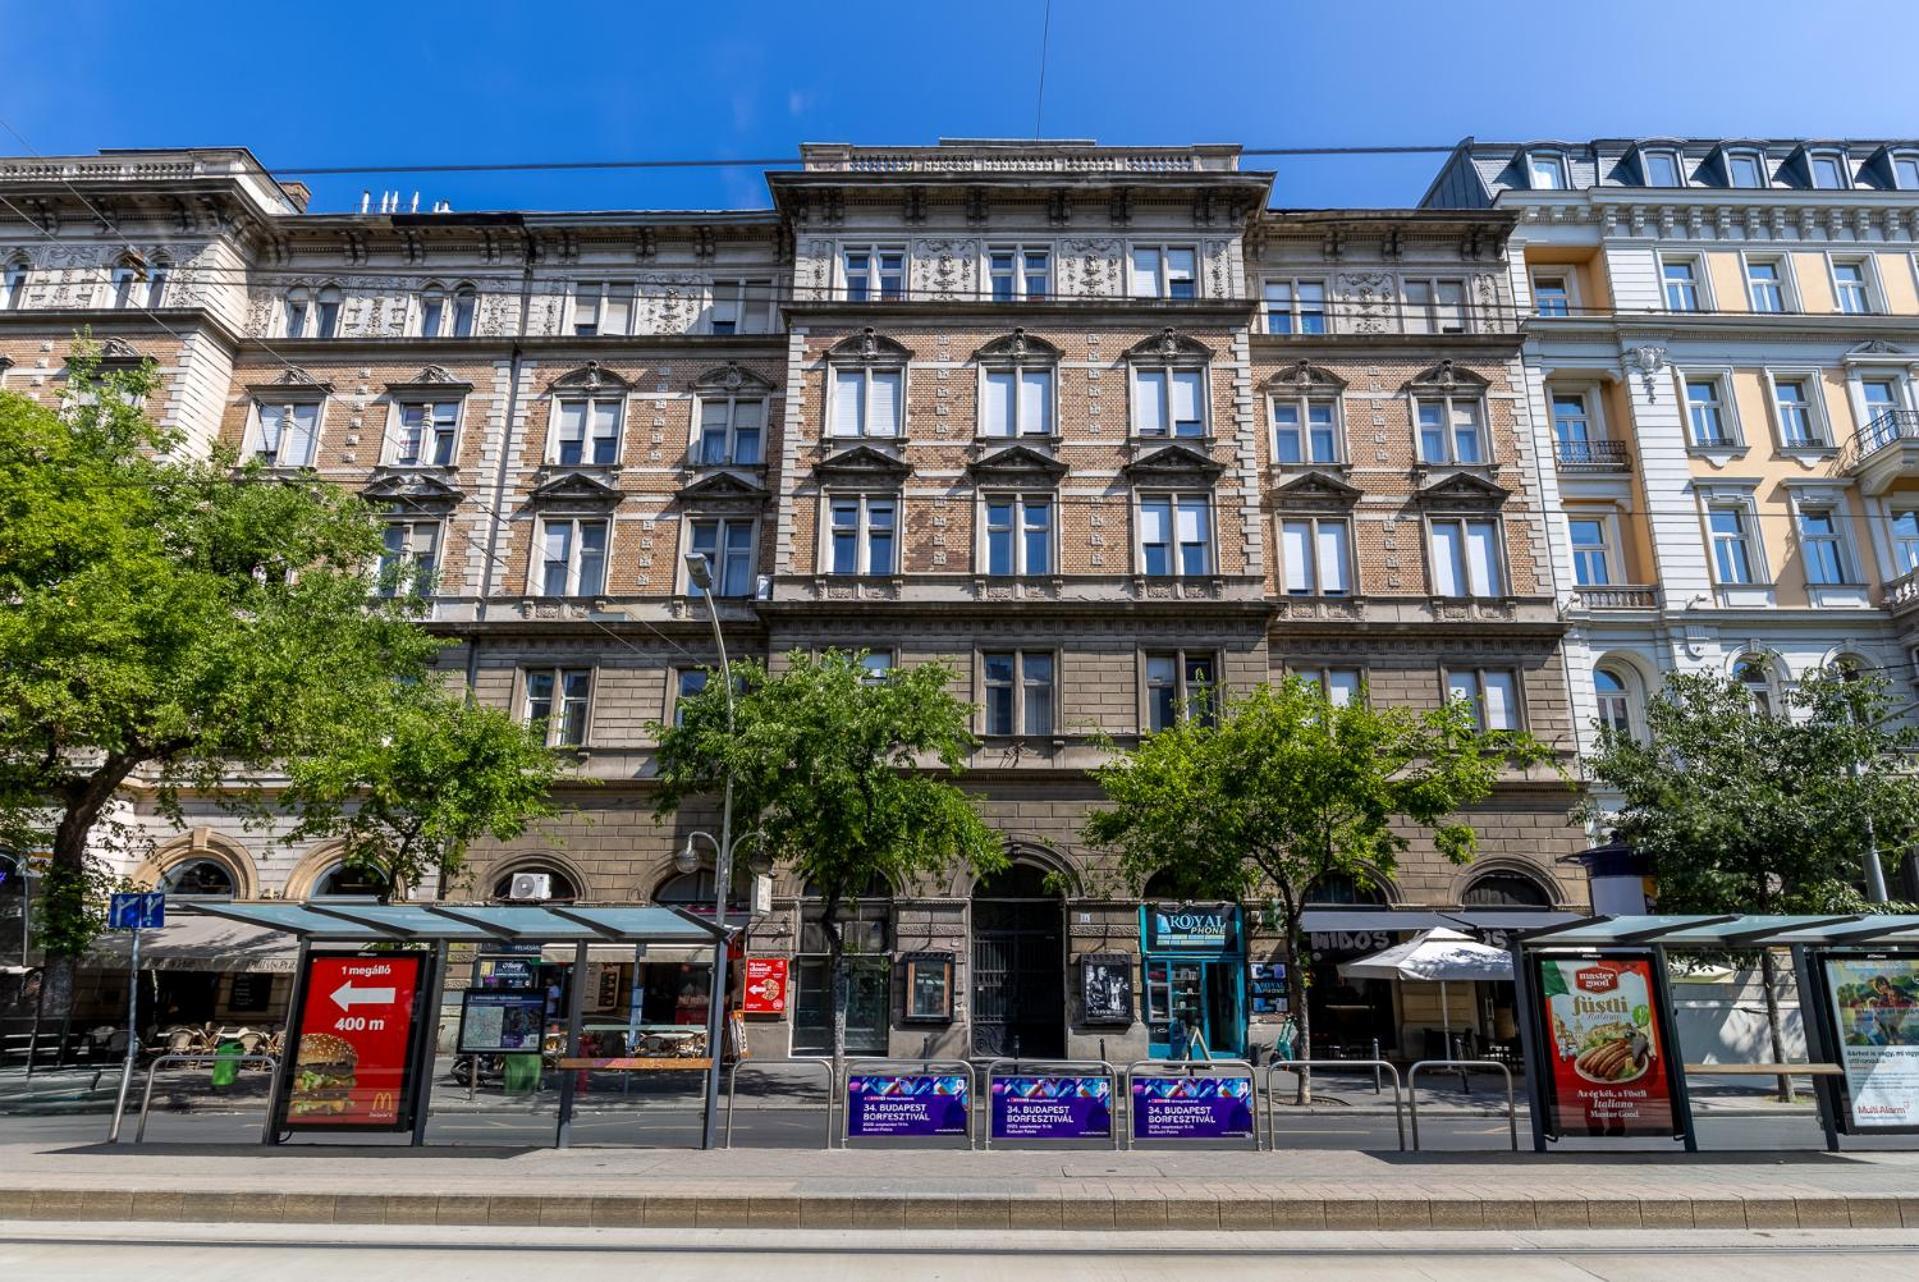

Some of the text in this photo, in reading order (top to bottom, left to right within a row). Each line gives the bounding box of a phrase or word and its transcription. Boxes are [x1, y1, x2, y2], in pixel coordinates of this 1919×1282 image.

[1170, 913, 1225, 929] ROYAL
[342, 965, 391, 977] 1 megálló
[1586, 980, 1609, 988] good
[1572, 996, 1628, 1016] füstli
[334, 1017, 385, 1031] 400 m
[864, 1104, 927, 1112] 34. BUDAPEST
[1594, 1099, 1634, 1108] Italiano
[1007, 1106, 1070, 1114] 34. BUDAPEST
[1148, 1106, 1212, 1114] 34. BUDAPEST
[863, 1112, 931, 1121] BORFESZTIVÁL
[1007, 1114, 1074, 1123] BORFESZTIVÁL
[1148, 1114, 1216, 1123] BORFESZTIVÁL
